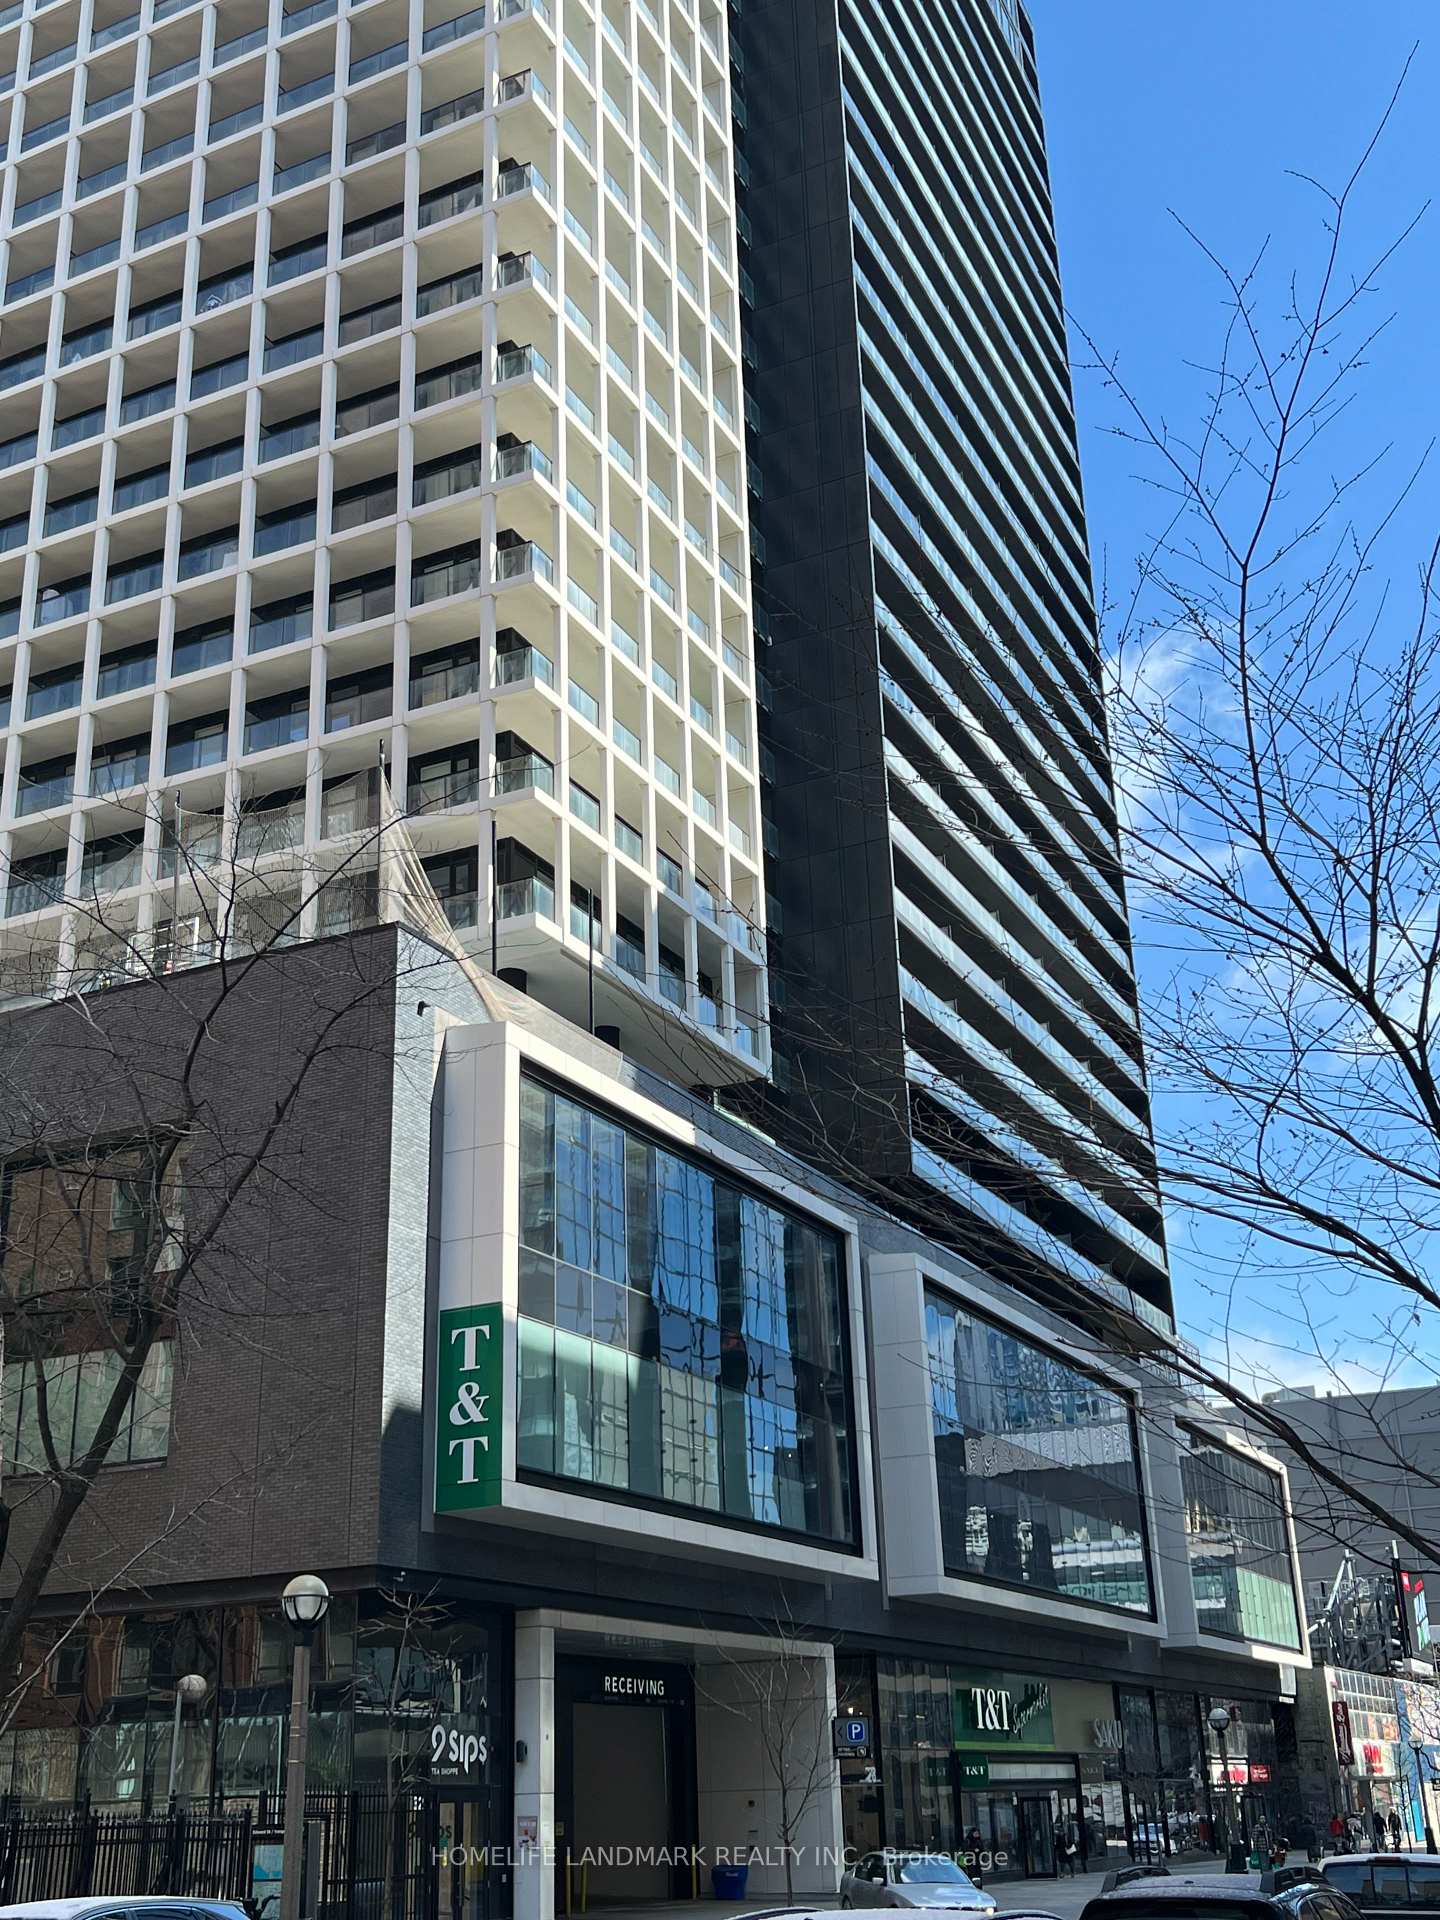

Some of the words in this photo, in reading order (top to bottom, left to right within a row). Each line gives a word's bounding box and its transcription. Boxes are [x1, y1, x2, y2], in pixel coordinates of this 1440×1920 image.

[449, 1325, 490, 1484] T&T
[604, 1675, 664, 1696] RECEIVING
[972, 1687, 1011, 1730] T&T
[852, 1724, 861, 1739] P
[963, 1766, 986, 1775] T&T
